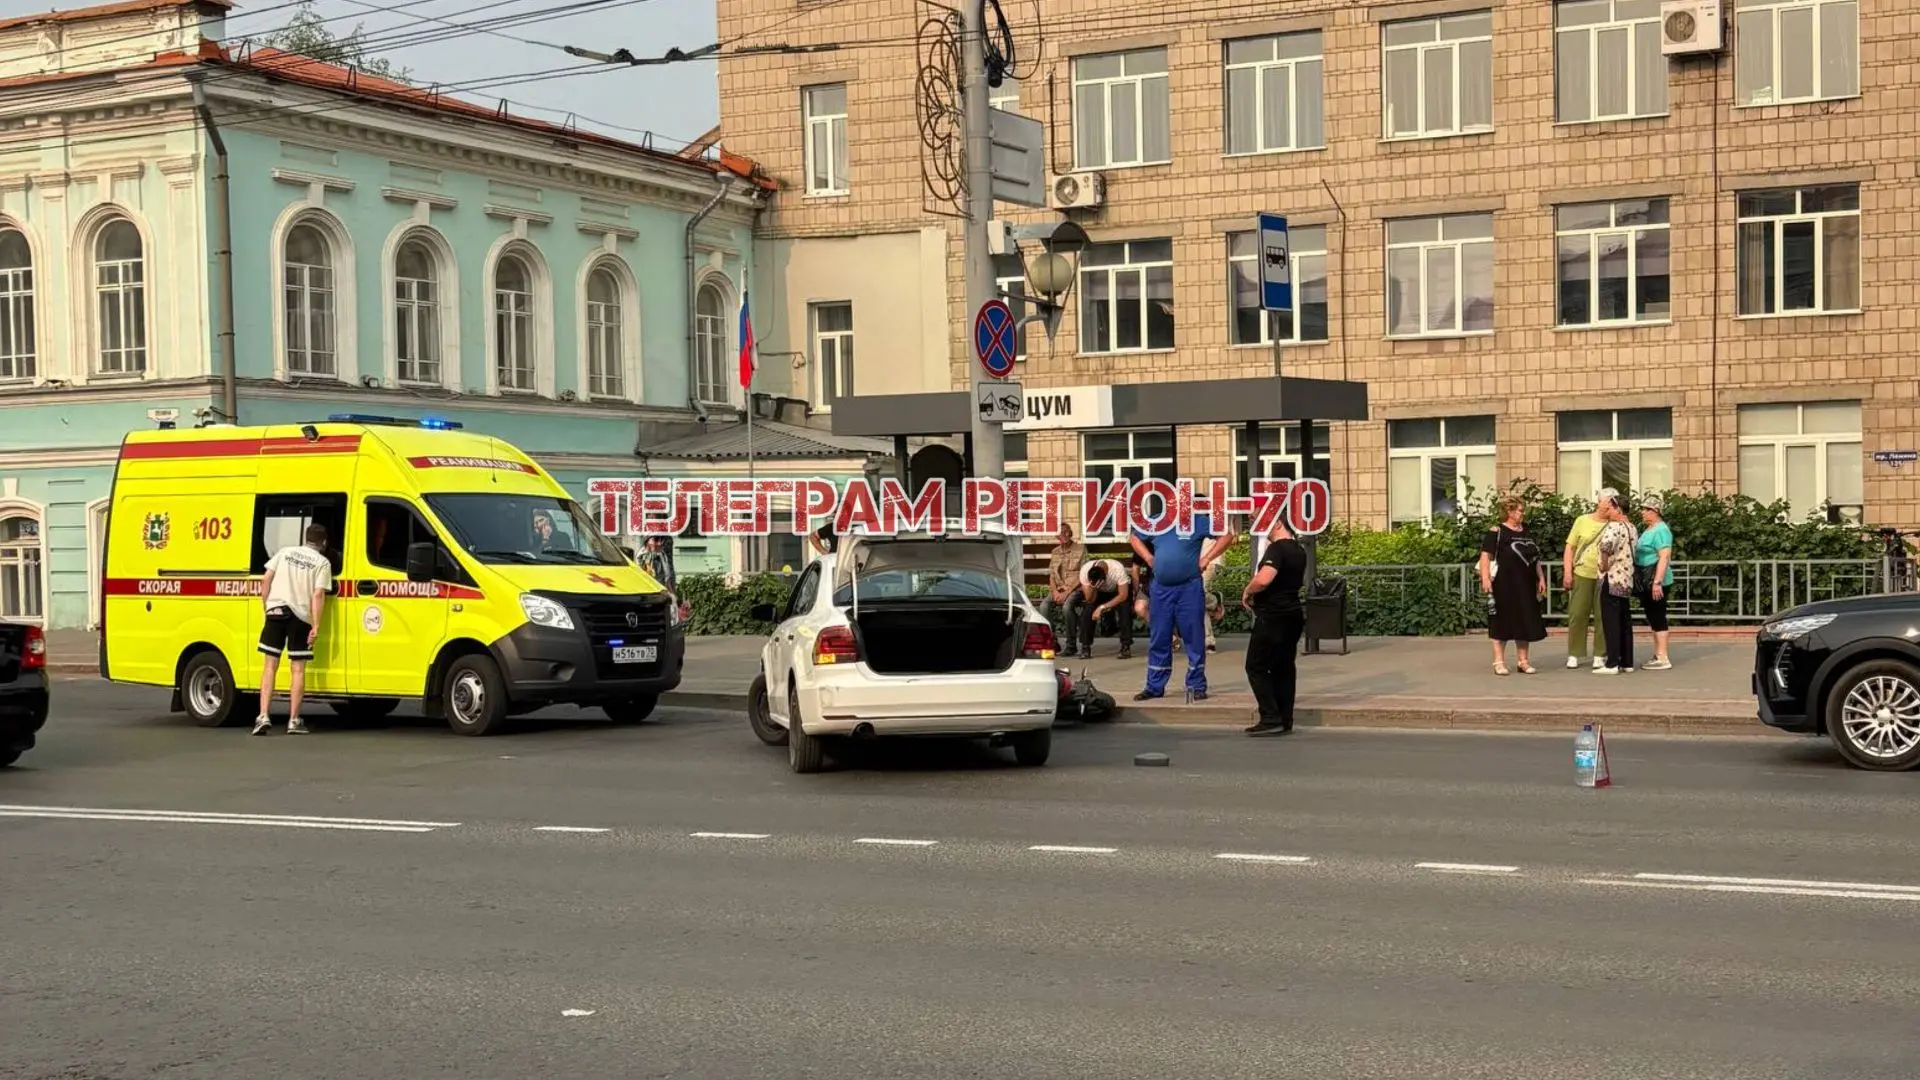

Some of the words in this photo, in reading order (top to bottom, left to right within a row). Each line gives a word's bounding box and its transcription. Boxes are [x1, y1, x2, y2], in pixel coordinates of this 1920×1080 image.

[1027, 394, 1072, 420] ЦУМ
[428, 456, 524, 472] РЕАНИМАЦИЯ
[199, 517, 232, 540] 103
[138, 580, 181, 594] СКОРАЯ
[380, 581, 440, 598] ПОМОЩЬ
